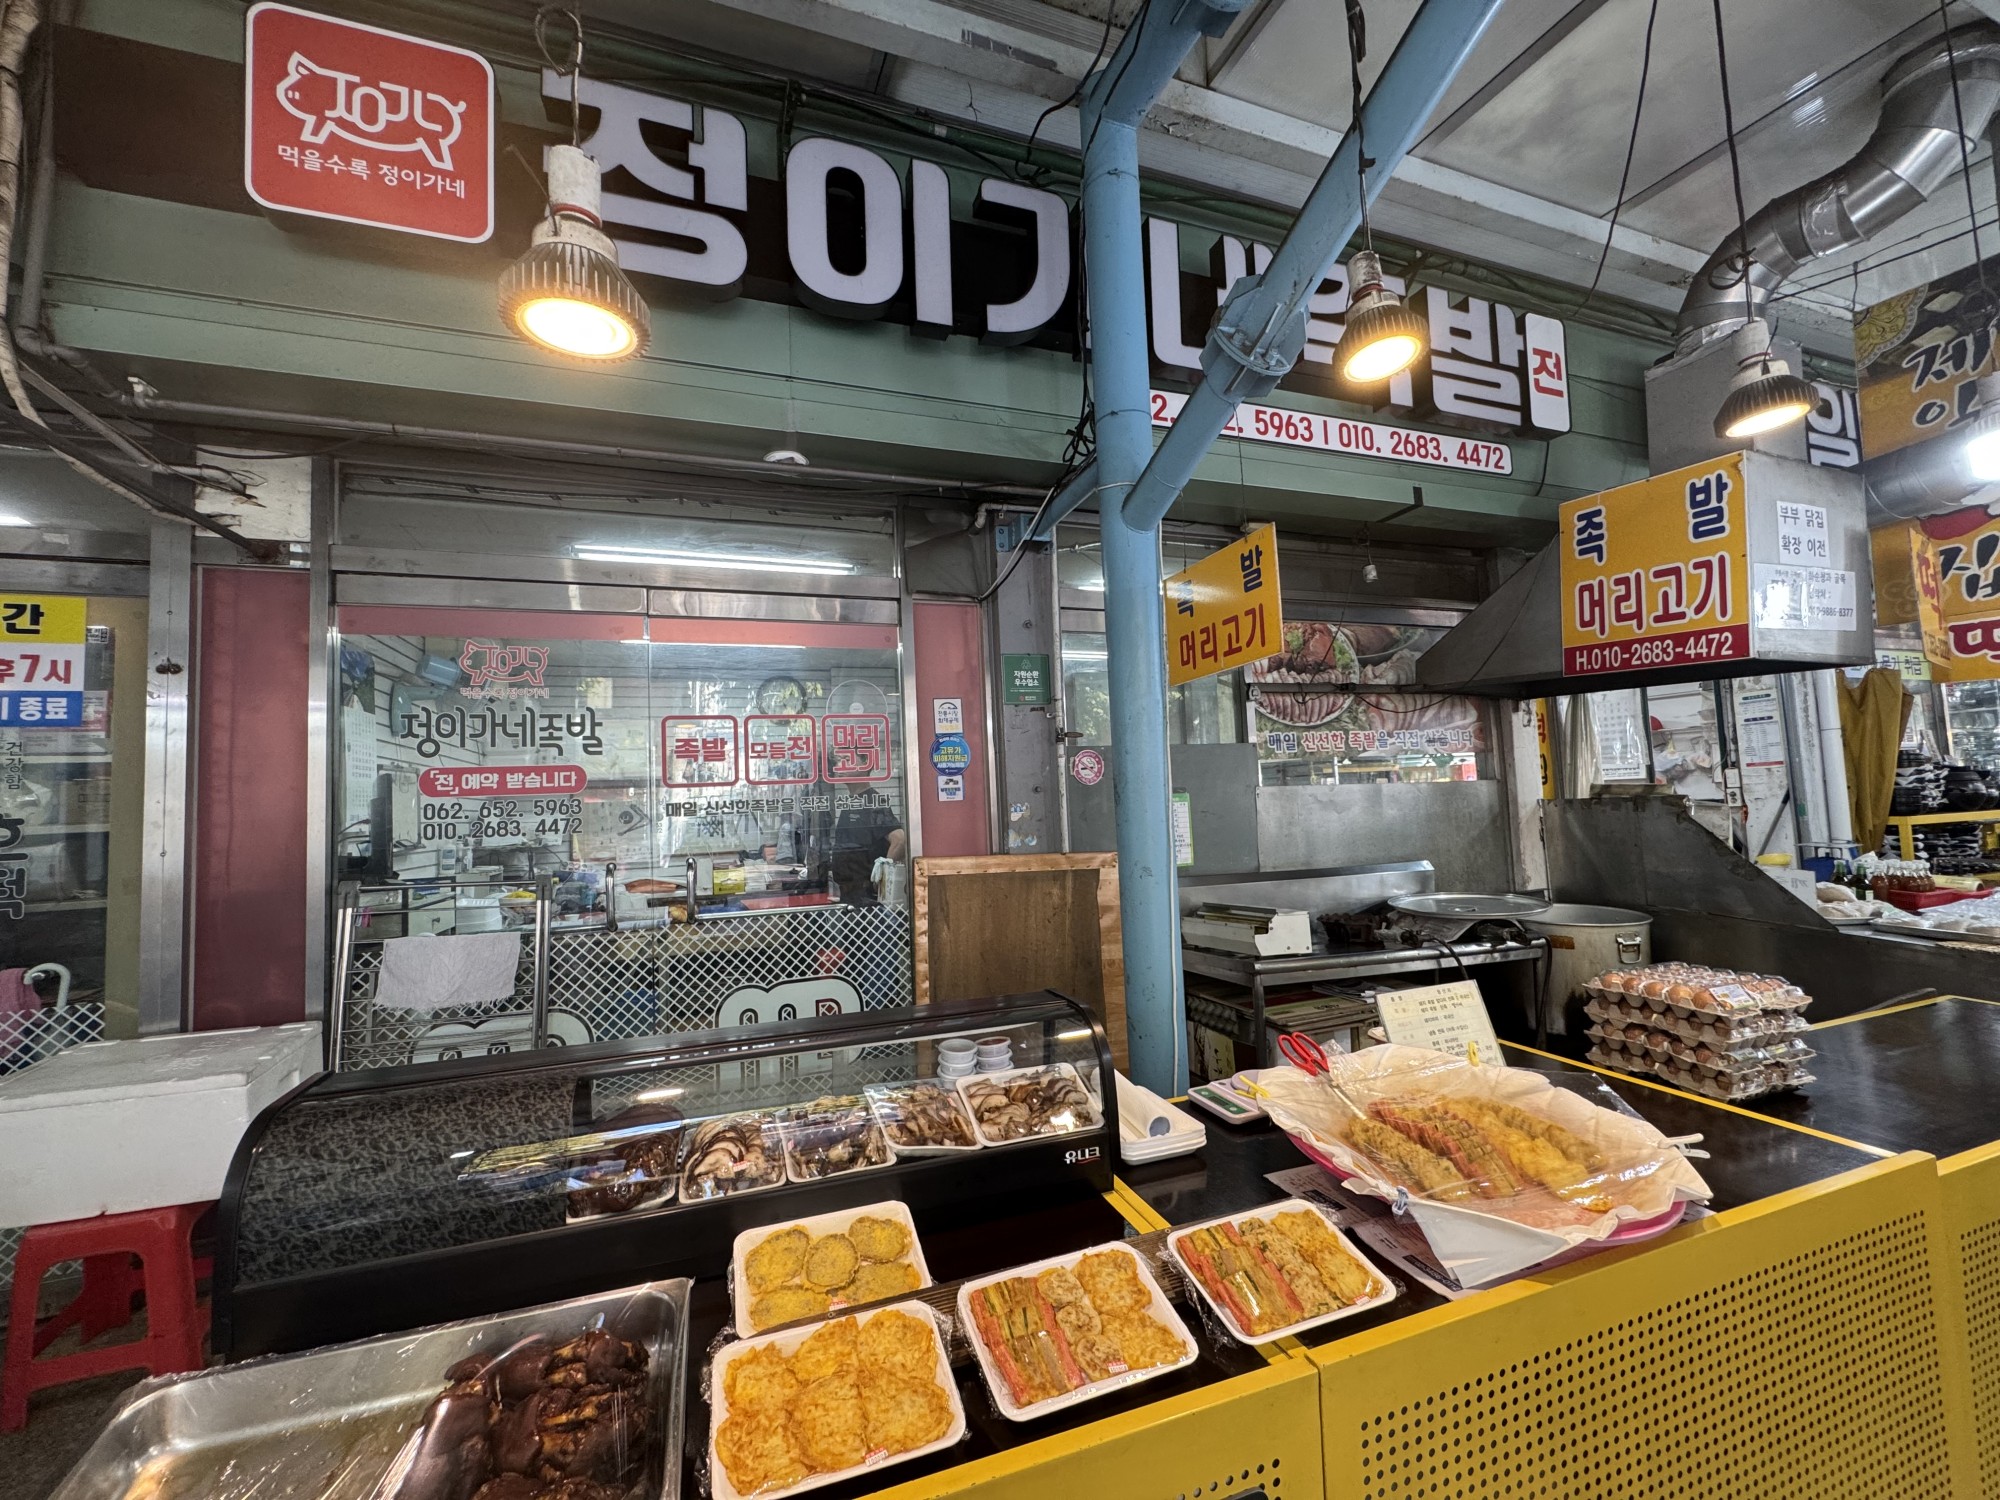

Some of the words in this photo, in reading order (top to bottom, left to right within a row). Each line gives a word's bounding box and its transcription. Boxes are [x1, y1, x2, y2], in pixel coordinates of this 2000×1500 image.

[277, 144, 371, 181] 먹을수록
[378, 161, 466, 199] 정이가네
[1531, 347, 1565, 399] 전
[1254, 408, 1314, 443] 5963
[1338, 422, 1382, 454] 010.
[1390, 430, 1449, 464] 2683.
[1456, 441, 1506, 470] 4472
[1574, 507, 1607, 564] 족
[1689, 474, 1729, 540] 발
[1780, 505, 1800, 526] 부부
[1805, 509, 1825, 529] 닭집
[1781, 534, 1801, 555] 확장
[1807, 538, 1827, 558] 이전
[1240, 545, 1262, 593] 발
[1577, 555, 1730, 635] 머리고기
[2, 603, 44, 634] 간
[1179, 603, 1266, 670] 머리고기
[1576, 632, 1733, 671] H.010-2683-4472
[507, 687, 549, 699] 정이가네
[19, 697, 68, 721] 종료
[400, 706, 604, 758] 정이가네족발
[1268, 732, 1298, 751] 매일
[1302, 730, 1345, 751] 신선한
[1349, 730, 1390, 750] 족발을
[1394, 730, 1420, 748] 직접
[673, 738, 728, 762] 족발
[750, 736, 812, 760] 모듬전
[461, 773, 500, 790] 예약
[506, 771, 578, 788] 받습니다
[422, 803, 470, 821] 062.
[479, 800, 525, 818] 652.
[533, 799, 583, 816] 5963
[666, 802, 698, 817] 매일
[801, 795, 830, 812] 직접
[836, 794, 891, 809] 삶습니다
[422, 823, 464, 841] 010.
[471, 821, 527, 838] 2683.
[535, 818, 584, 835] 4472
